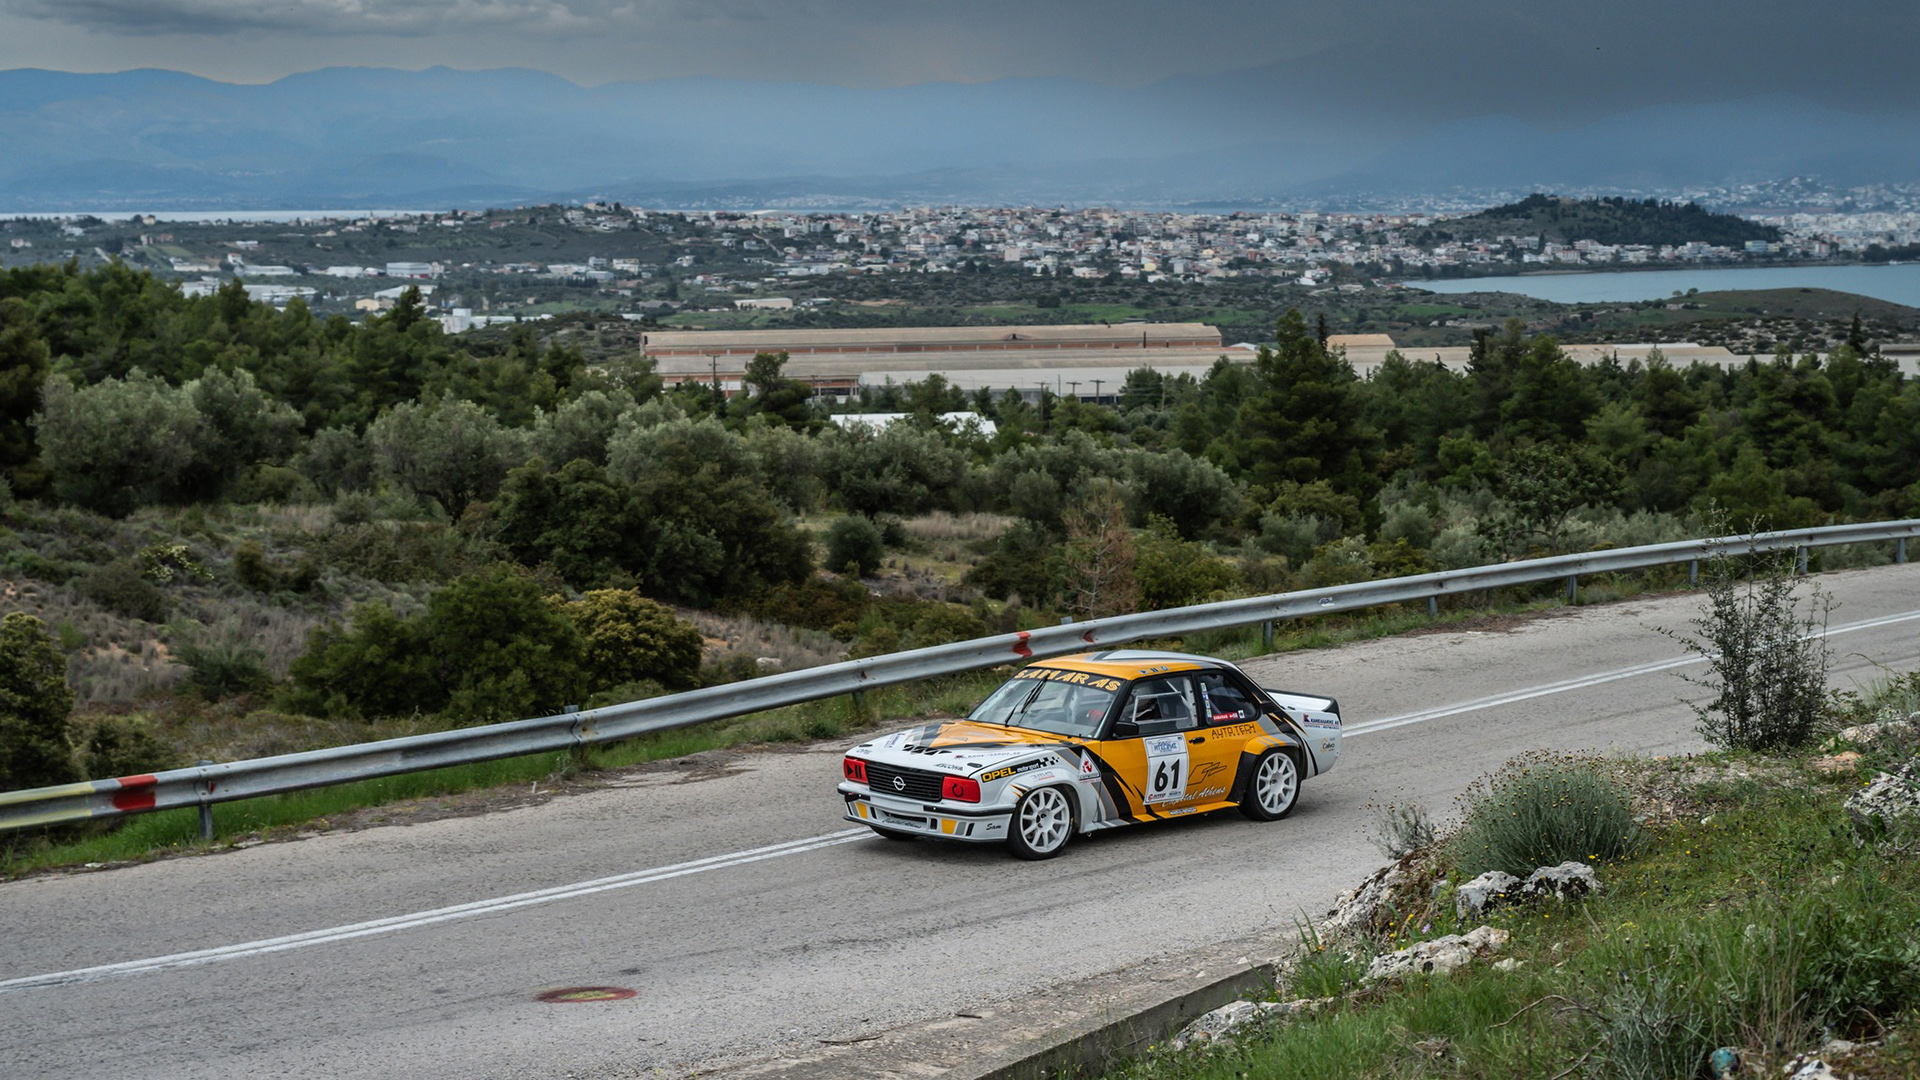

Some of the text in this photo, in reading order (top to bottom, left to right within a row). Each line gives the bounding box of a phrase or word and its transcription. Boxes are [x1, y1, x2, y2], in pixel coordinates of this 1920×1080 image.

[1014, 669, 1121, 691] SAMARAS
[981, 767, 1017, 783] OPEL
[1016, 763, 1040, 773] motorsport
[1153, 758, 1181, 793] 61
[1196, 786, 1226, 800] Athens
